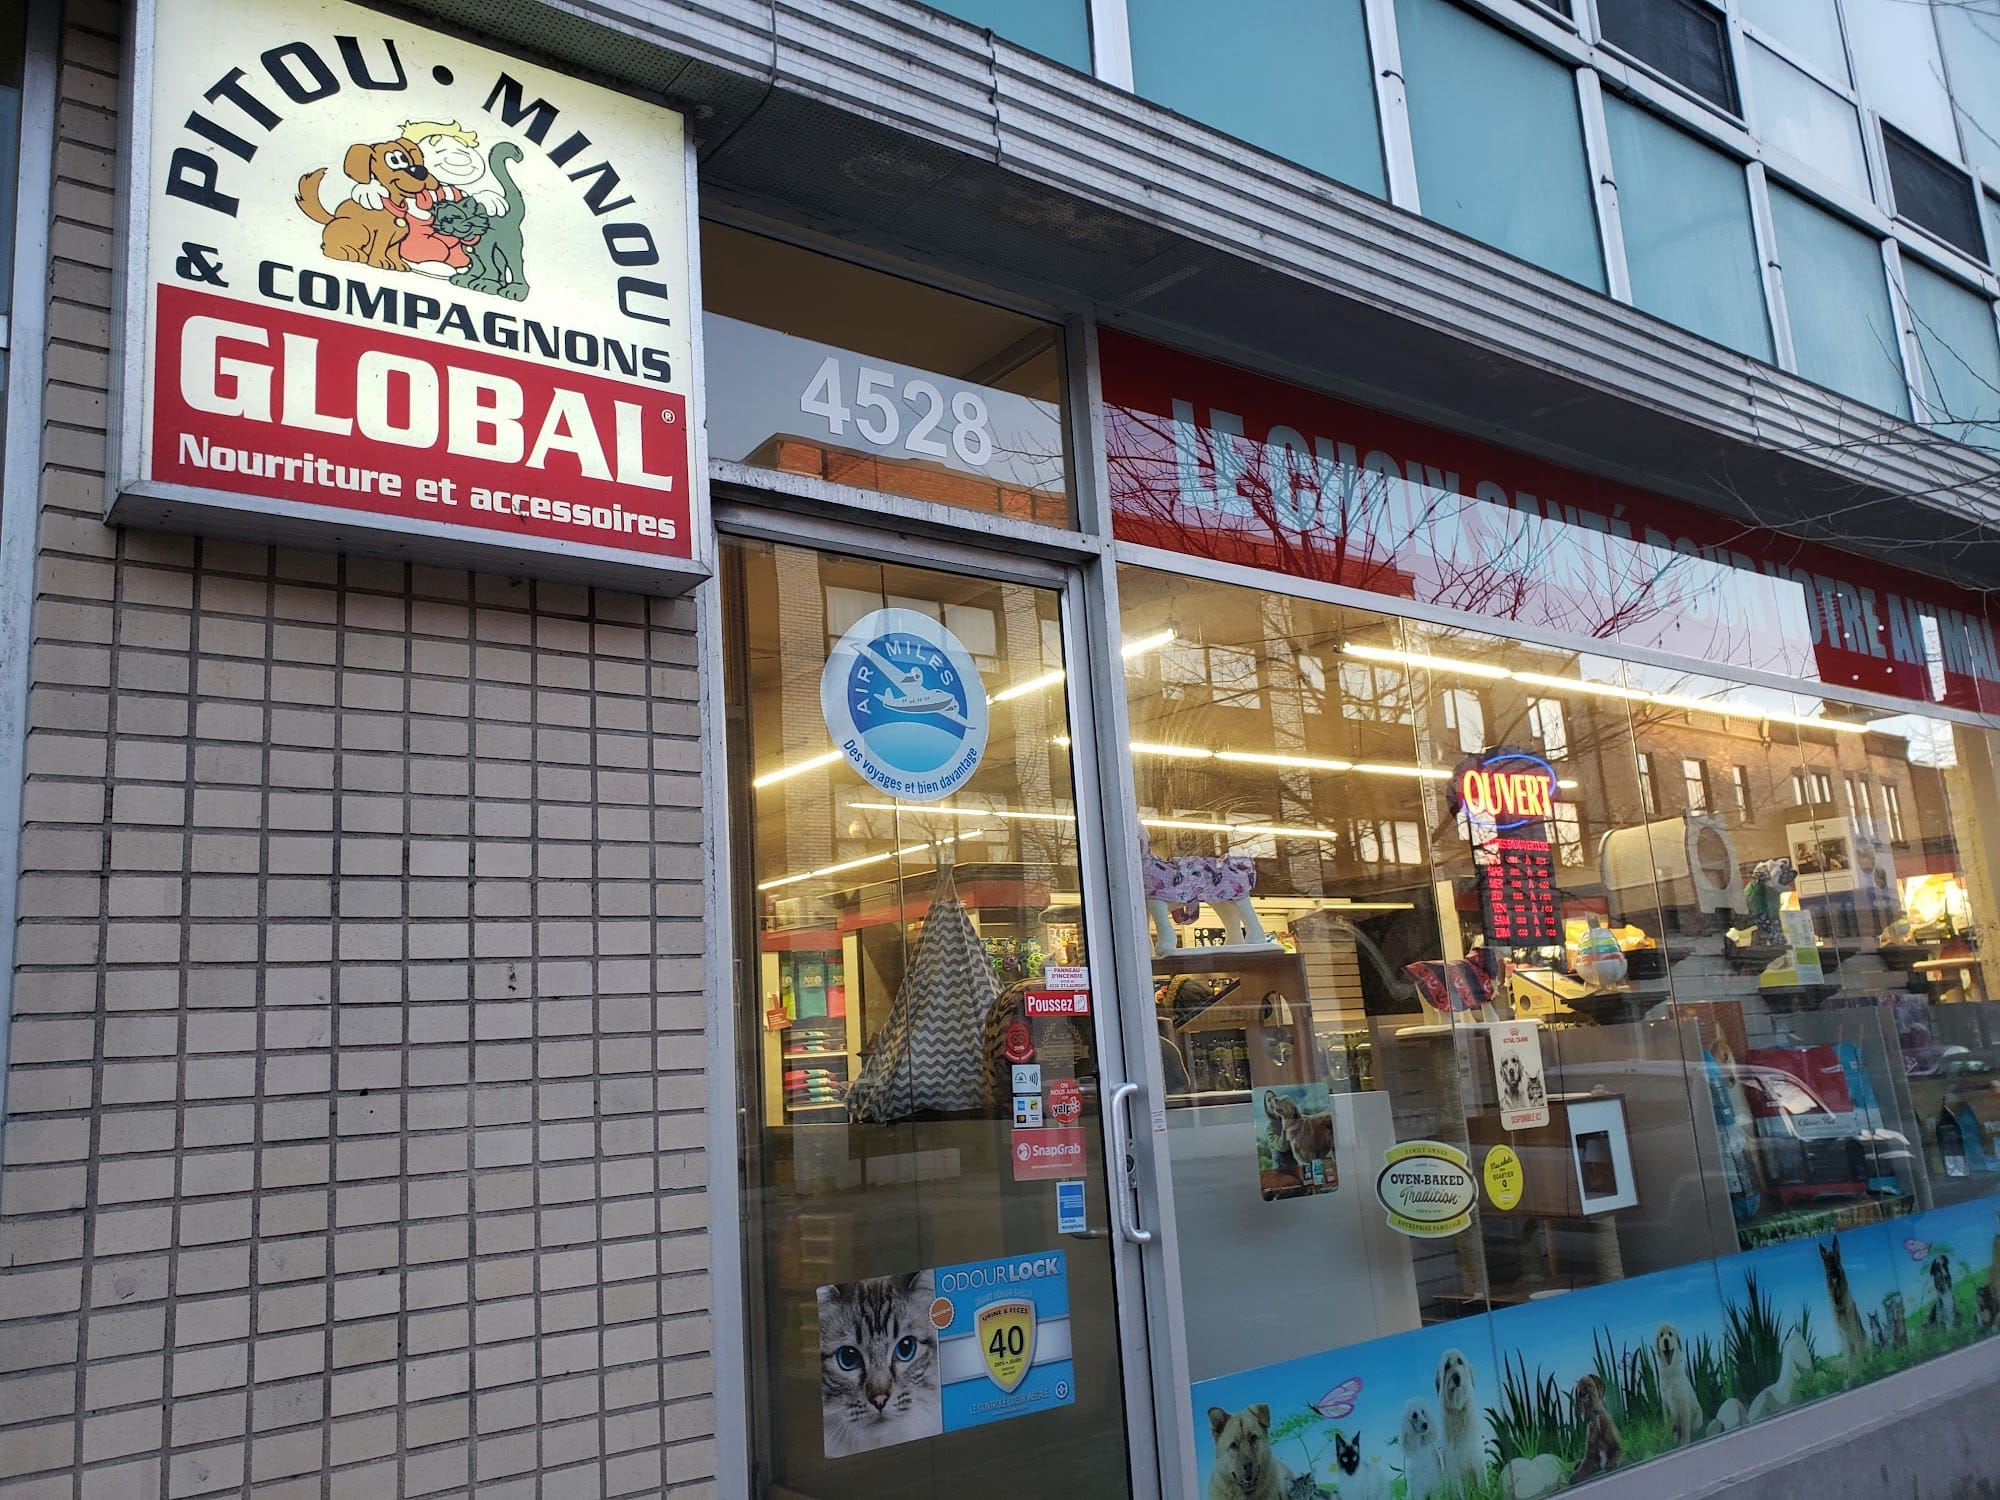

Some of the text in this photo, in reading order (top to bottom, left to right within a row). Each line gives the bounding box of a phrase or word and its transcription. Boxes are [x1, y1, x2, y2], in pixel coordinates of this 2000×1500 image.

[165, 35, 671, 327] PITOU MINOU
[176, 241, 672, 384] & COMPAGNONS
[179, 315, 674, 493] GLOBAL
[800, 356, 994, 467] 4528
[178, 432, 676, 540] Nourriture et accessoires
[1171, 397, 1255, 518] LE
[1266, 424, 1473, 563] CHOIX
[1476, 480, 1644, 602] SANTÉ
[1644, 524, 1769, 633] POUR
[856, 640, 954, 715] AIR MILES
[843, 739, 978, 794] Des voyages et bien davantage
[1463, 769, 1553, 818] OUVERT
[1027, 995, 1073, 1013] Poussez
[1053, 1102, 1071, 1116] yelp
[1032, 1143, 1081, 1157] SnapGrab
[1400, 1185, 1459, 1206] Tradition
[941, 1257, 1060, 1293] ODOURLOCK
[989, 1325, 1025, 1359] 40
